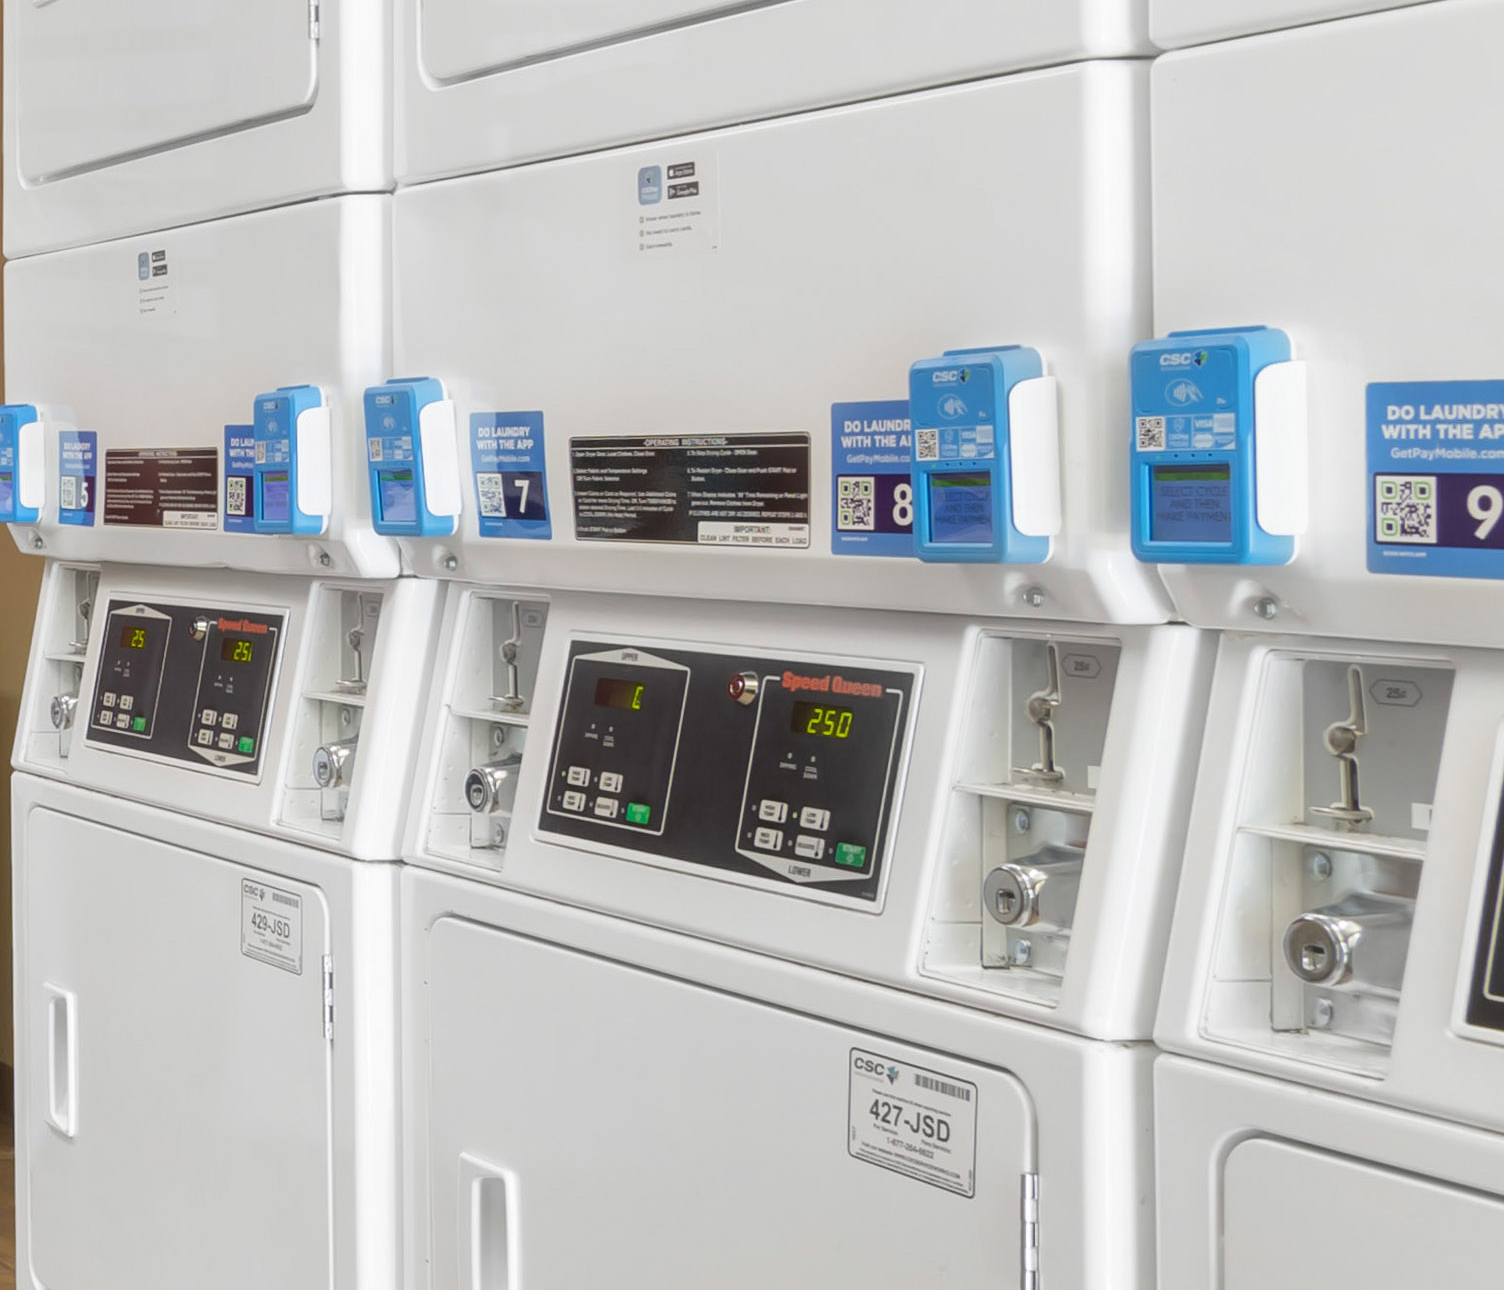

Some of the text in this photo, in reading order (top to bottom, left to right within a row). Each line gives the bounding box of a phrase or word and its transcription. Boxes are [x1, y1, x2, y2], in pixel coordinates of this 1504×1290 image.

[1159, 353, 1192, 366] CSC
[932, 370, 959, 382] CSC
[1386, 404, 1415, 421] DO
[477, 426, 530, 439] DO LAUNDRY
[844, 419, 911, 433] DO LAUNDR
[1381, 423, 1504, 440] WITH THE AP
[476, 439, 534, 451] WITH THE APP
[841, 435, 872, 448] WITH
[874, 435, 896, 448] THE
[846, 453, 911, 465] GetPayMobile.co
[78, 481, 89, 508] 5
[514, 479, 530, 514] 7
[893, 482, 913, 527] 8
[1466, 484, 1504, 541] 9
[733, 525, 772, 535] IMPORTANT:
[700, 534, 808, 545] CLEAN LINT FILTER BEFORE EACH LOAD
[217, 617, 269, 634] Speed Queen
[620, 651, 639, 662] UPPER
[782, 671, 884, 698] Speed Queen
[806, 708, 853, 739] 250
[788, 866, 812, 878] LOWER
[243, 883, 259, 897] CSC
[251, 911, 291, 939] 429-JSD
[854, 1056, 886, 1076] CSC
[869, 1098, 951, 1143] 427-JSD
